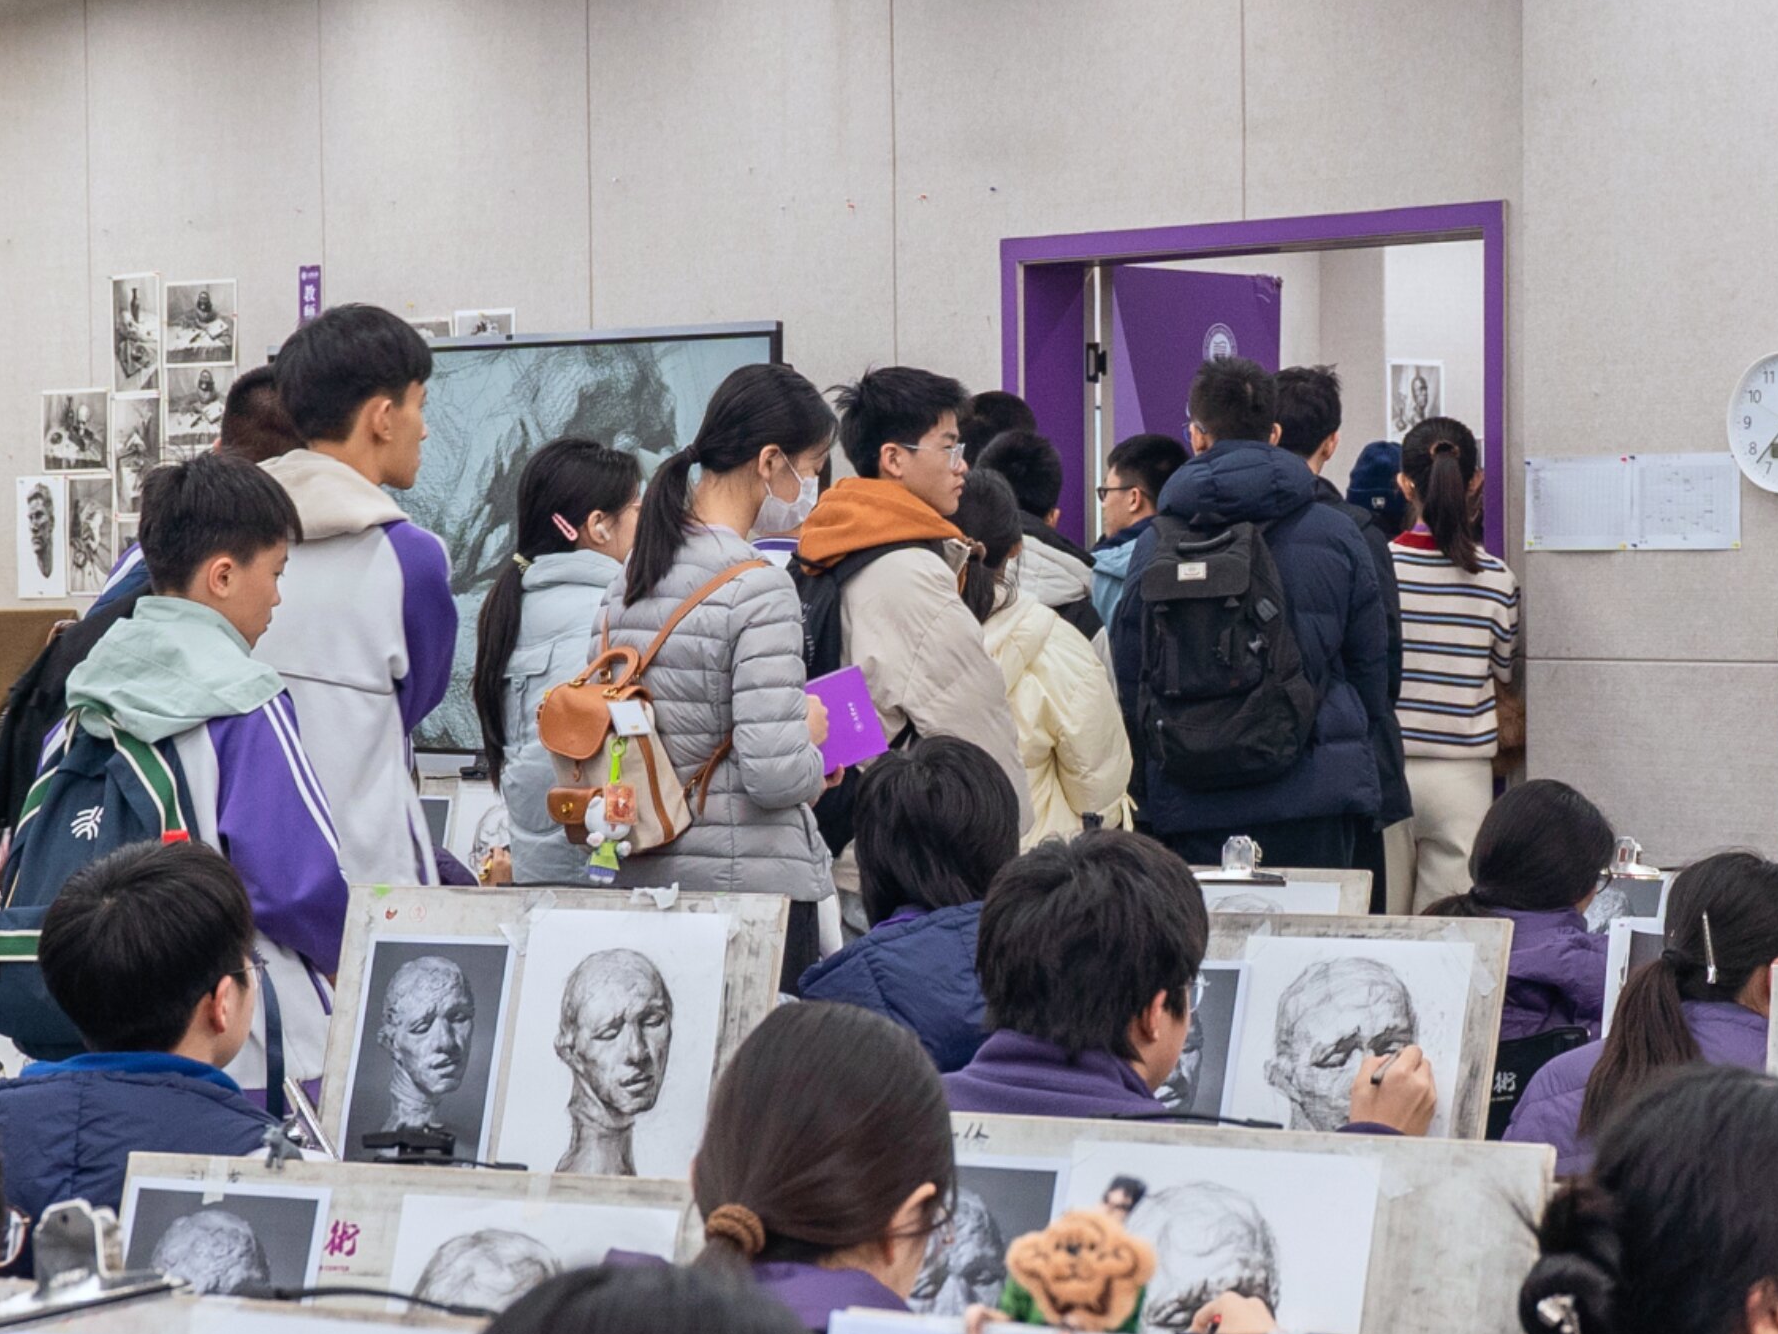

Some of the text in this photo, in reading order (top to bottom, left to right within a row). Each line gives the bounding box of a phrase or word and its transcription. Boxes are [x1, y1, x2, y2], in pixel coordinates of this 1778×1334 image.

[1763, 370, 1775, 384] 11
[1748, 389, 1762, 404] 10
[1743, 416, 1752, 429] 9
[1749, 441, 1757, 455] 8
[1765, 461, 1773, 475] 7
